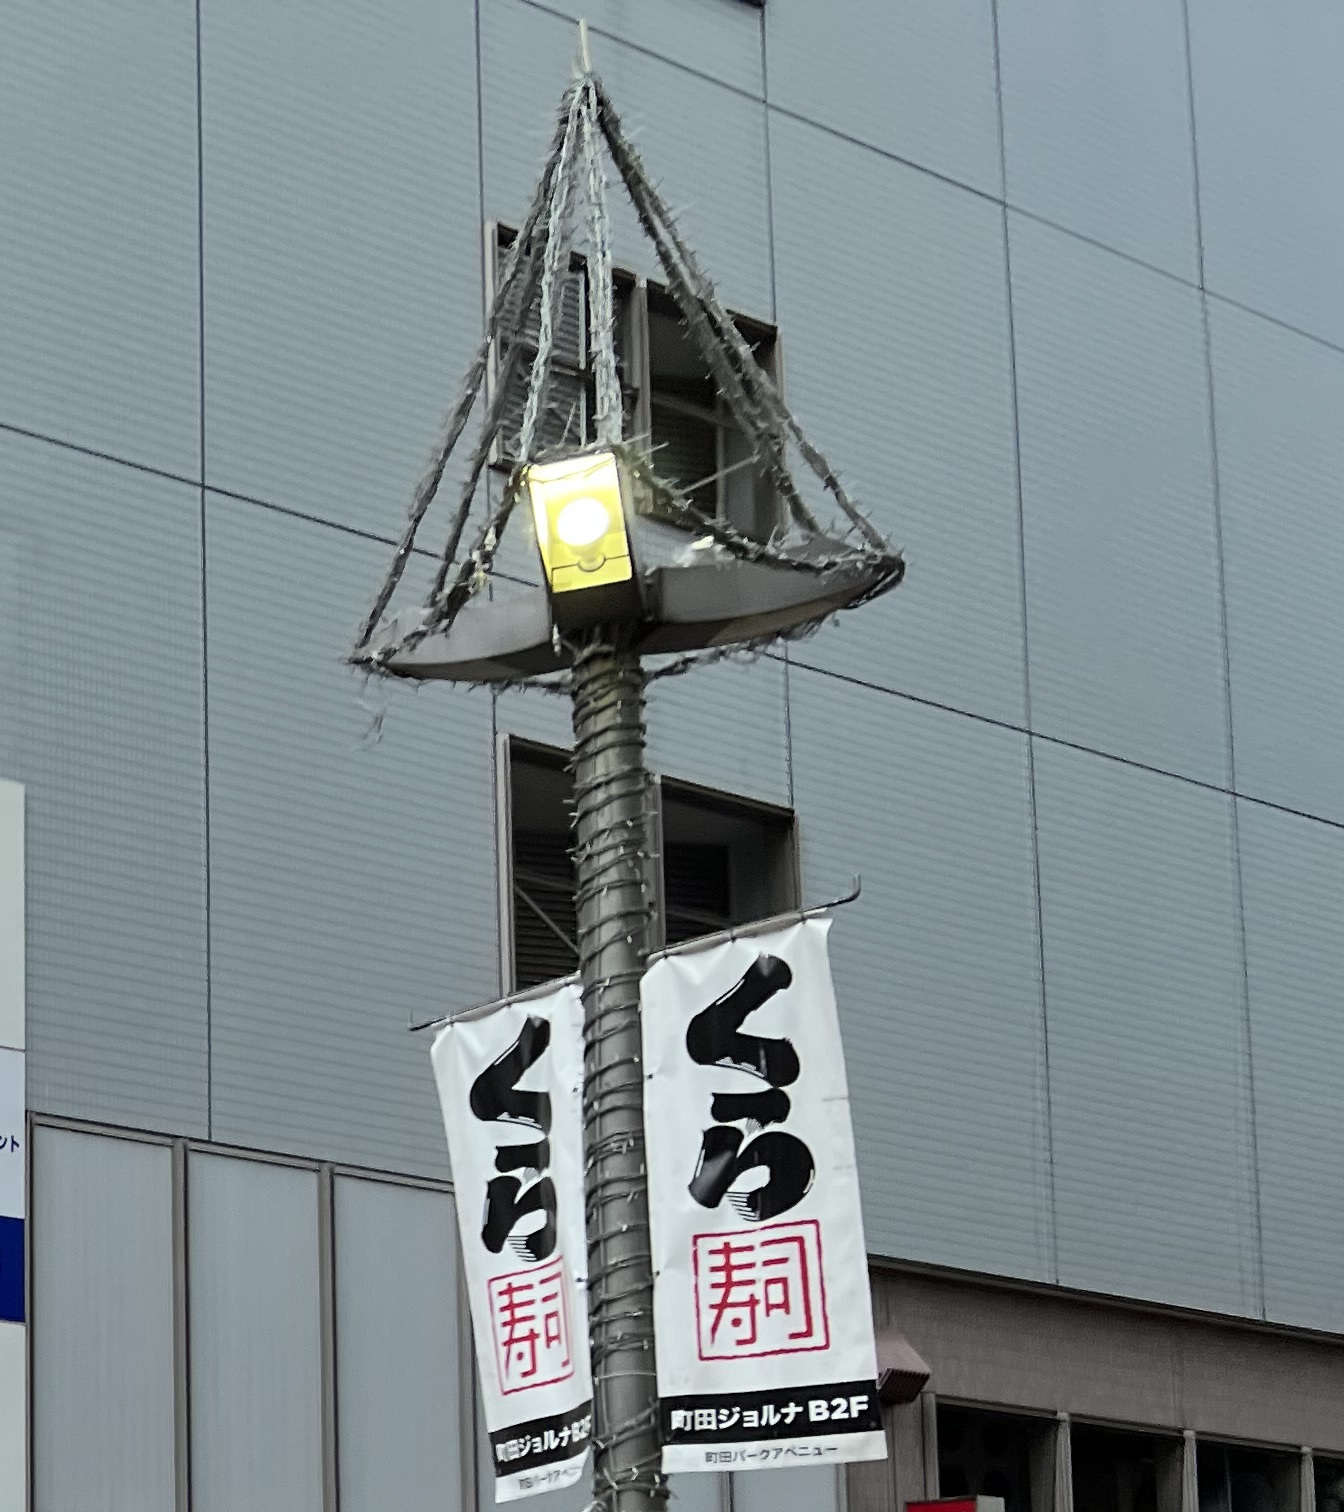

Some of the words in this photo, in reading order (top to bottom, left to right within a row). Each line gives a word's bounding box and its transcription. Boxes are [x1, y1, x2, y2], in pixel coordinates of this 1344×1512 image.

[670, 1401, 803, 1432] 町田ジョルナ
[808, 1395, 869, 1422] B2F
[705, 1445, 838, 1463] 町田パークアベニュー
